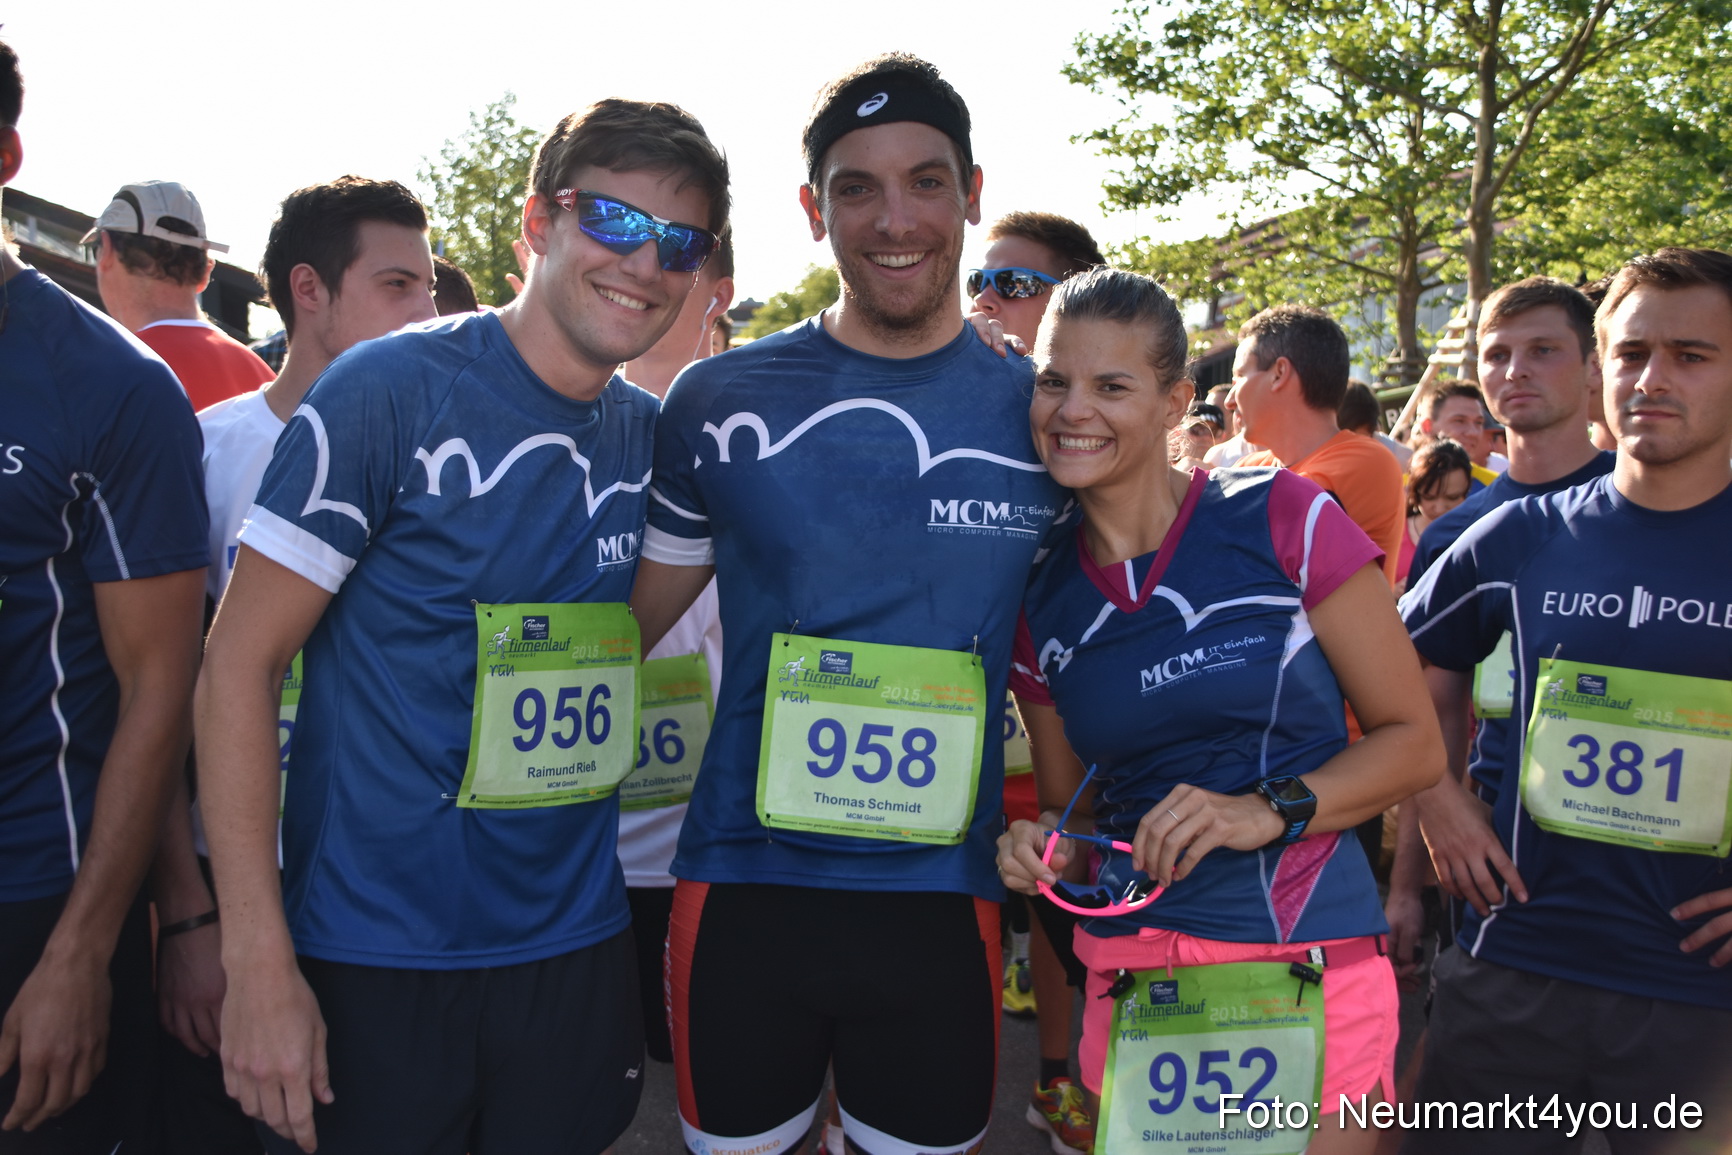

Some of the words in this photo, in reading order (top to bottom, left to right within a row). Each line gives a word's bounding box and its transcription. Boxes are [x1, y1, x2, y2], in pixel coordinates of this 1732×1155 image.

[555, 189, 575, 197] UDY
[0, 443, 25, 474] S
[929, 499, 1011, 525] MCM
[959, 528, 1002, 536] COMPUTER
[1006, 531, 1038, 541] MANAGING
[1542, 591, 1623, 618] EURO
[509, 637, 572, 652] firmenlauf
[1208, 635, 1266, 654] IT-Einfach
[1140, 648, 1204, 690] MCM
[1166, 671, 1202, 689] COMPUTER
[1207, 661, 1247, 674] MANAGING
[803, 668, 881, 689] firmenlauf
[881, 686, 921, 701] 2015
[512, 684, 612, 752] 956
[1561, 689, 1633, 710] firmenlauf
[1633, 707, 1674, 723] 2015
[807, 718, 937, 788] 958
[527, 763, 575, 779] Raimund
[576, 760, 597, 773] Rieß
[1562, 734, 1684, 803] 381
[547, 780, 561, 789] MCM
[562, 779, 578, 788] GmbH
[814, 791, 865, 808] Thomas
[868, 798, 922, 813] Schmidt
[1562, 798, 1609, 815] Michael
[1612, 808, 1681, 827] Bachmann
[845, 812, 863, 820] MCM
[864, 813, 885, 822] GmbH
[1139, 999, 1207, 1018] firmenlauf
[1209, 1006, 1248, 1021] 2015
[1148, 1046, 1278, 1115] 952
[1142, 1129, 1174, 1142] Silke
